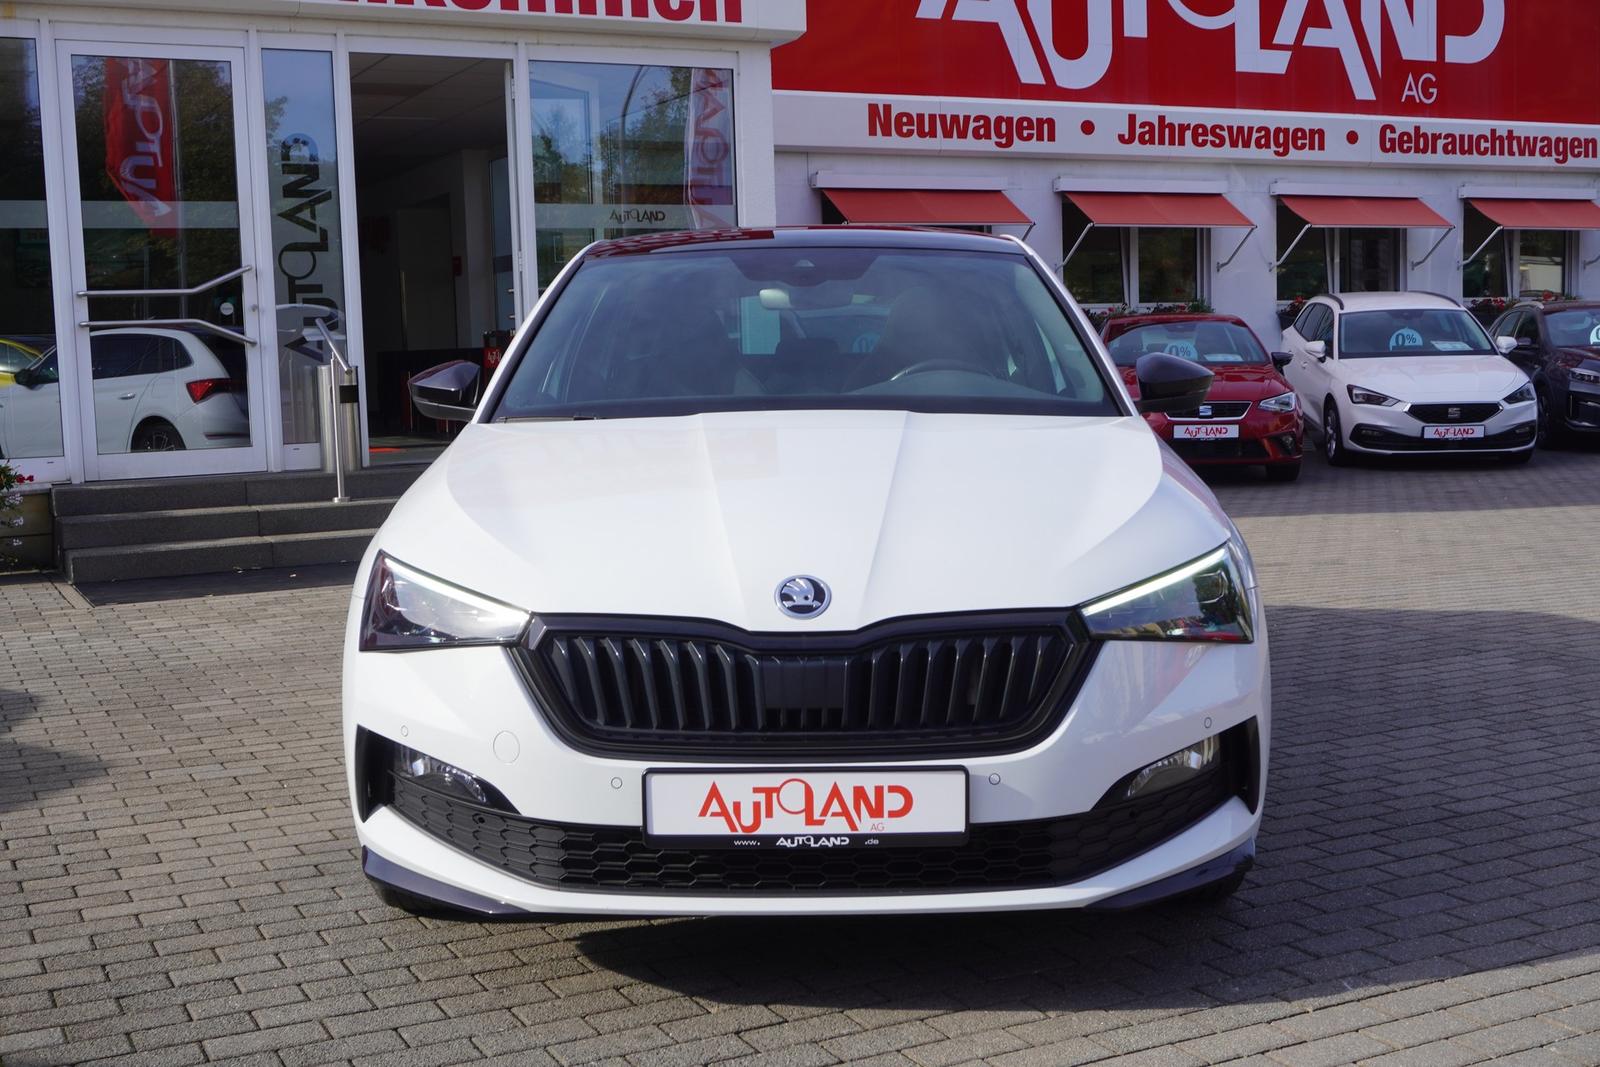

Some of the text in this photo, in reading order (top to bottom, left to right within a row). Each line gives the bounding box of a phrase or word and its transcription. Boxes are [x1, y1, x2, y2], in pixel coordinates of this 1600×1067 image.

[1401, 73, 1437, 104] AG
[868, 103, 1598, 164] Neuwagen Jahreswagen Gebrauchtwagen
[1394, 332, 1417, 347] 0%
[698, 778, 914, 833] AUTOLAND
[870, 822, 885, 832] AG
[776, 835, 850, 848] AUTOLAND
